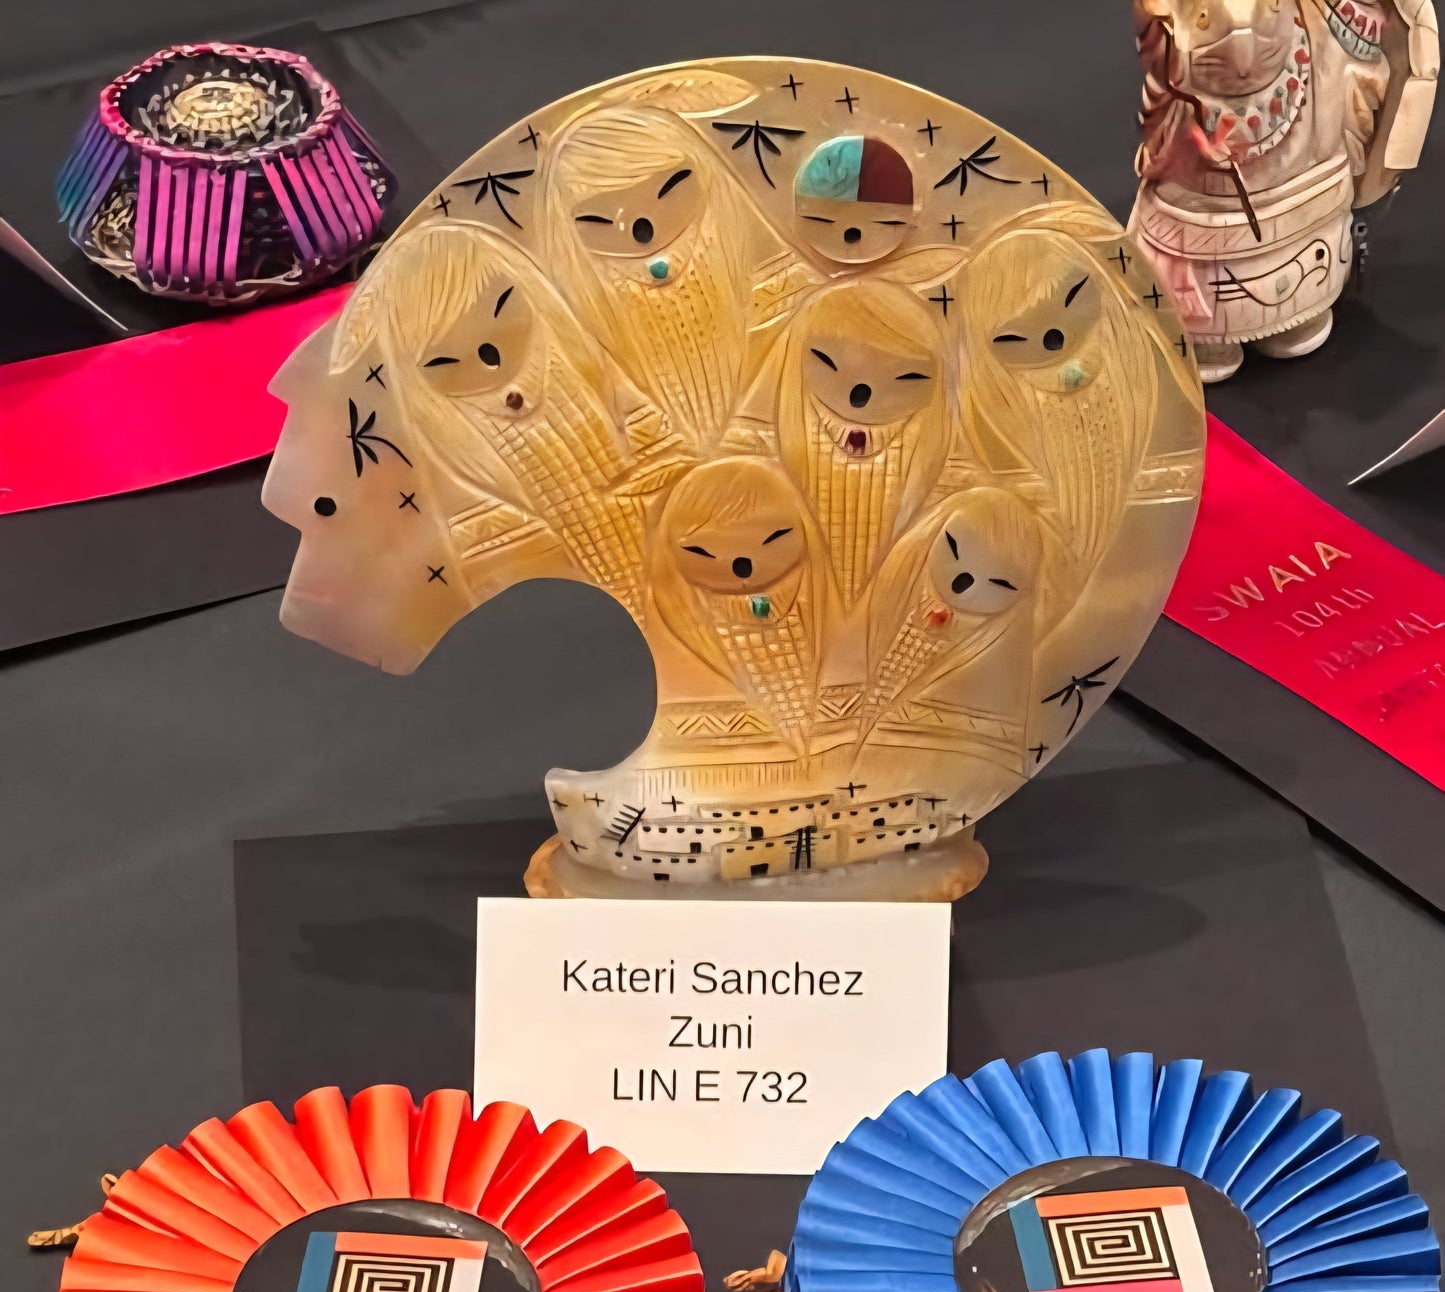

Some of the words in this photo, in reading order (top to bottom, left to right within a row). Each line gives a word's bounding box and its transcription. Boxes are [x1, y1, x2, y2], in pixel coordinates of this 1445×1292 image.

[1193, 542, 1352, 621] SWAIA
[562, 959, 675, 994] Kateri
[691, 961, 864, 996] Sanchez
[668, 1015, 753, 1049] Zuni
[612, 1068, 677, 1101] LIN
[695, 1070, 720, 1102] E
[736, 1071, 809, 1104] 732
